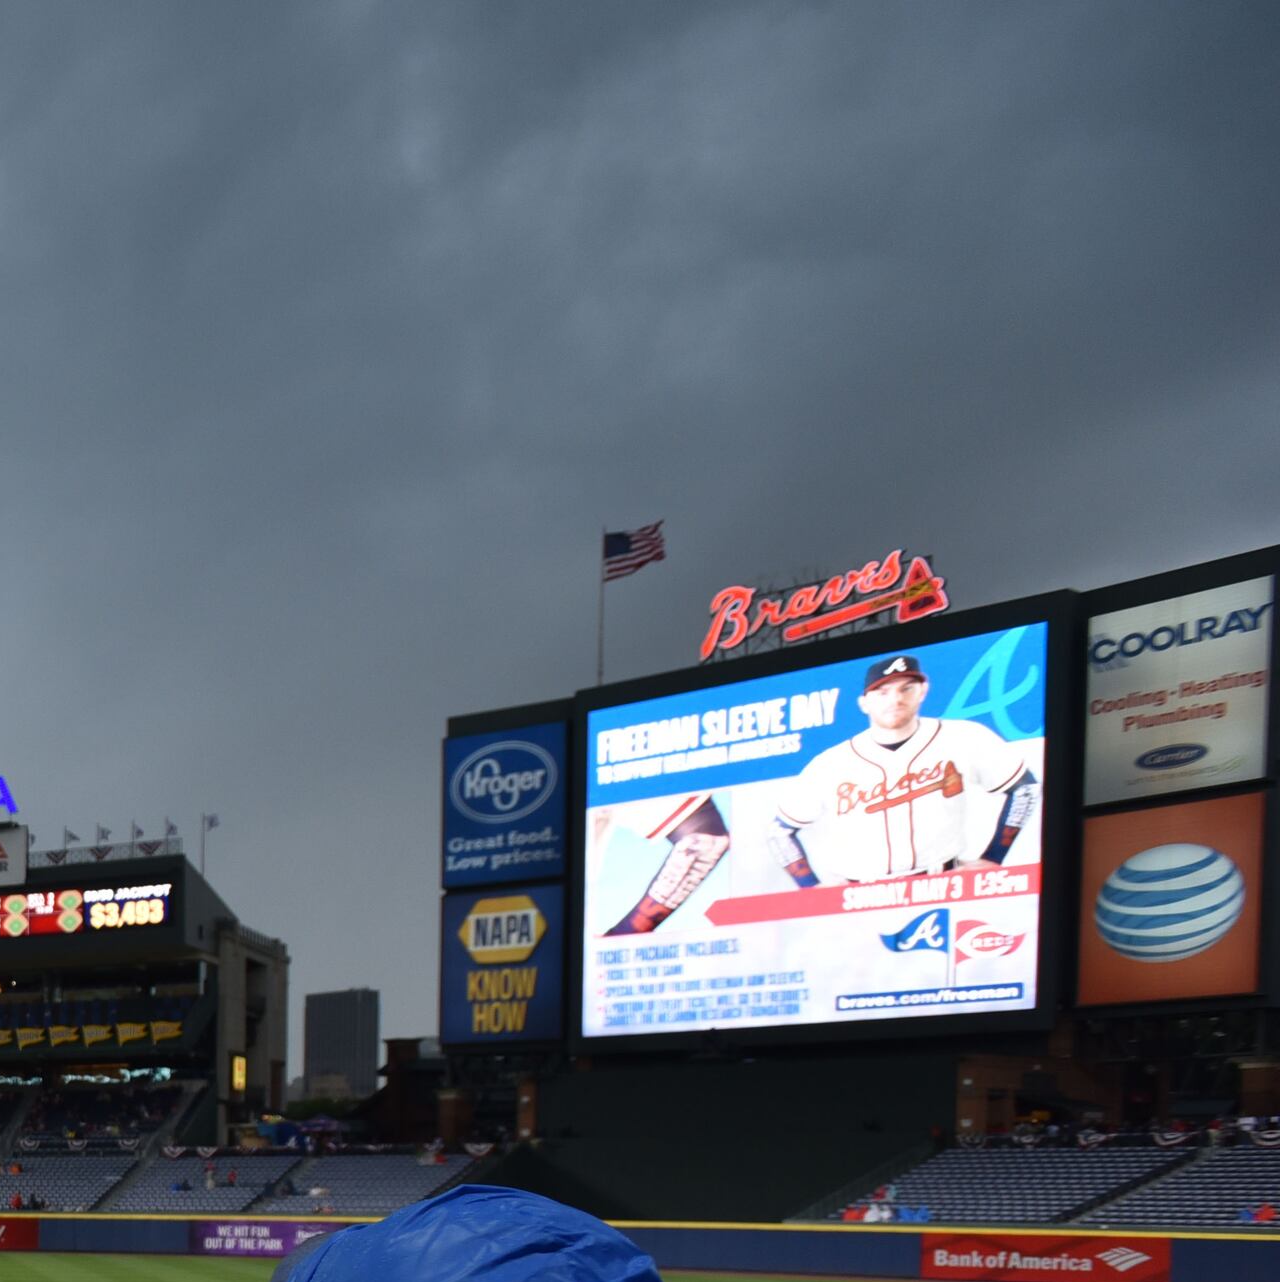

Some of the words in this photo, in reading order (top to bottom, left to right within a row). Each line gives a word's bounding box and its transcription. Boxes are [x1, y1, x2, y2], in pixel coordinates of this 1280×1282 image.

[700, 550, 902, 660] Braves
[1090, 602, 1275, 664] COOLRAY
[1090, 689, 1168, 716] Cooling
[1179, 670, 1268, 699] Heating
[597, 714, 699, 765] FREEMAN
[701, 698, 787, 747] SLEEVE
[789, 688, 839, 731] DAY
[1122, 702, 1228, 733] Plumbing
[464, 758, 546, 811] Kroger
[837, 759, 944, 817] Braves
[448, 834, 503, 853] Great
[507, 826, 560, 848] food.
[446, 854, 487, 872] Low
[491, 848, 561, 872] prices.
[114, 884, 172, 900] JACKPOT
[843, 881, 910, 911] SUNDAY,
[911, 876, 948, 904] MAY
[950, 875, 963, 899] 3
[89, 898, 165, 930] $3,493
[472, 914, 533, 949] NAPA
[971, 935, 1015, 948] REDS
[467, 967, 538, 1002] KNOW
[838, 986, 1019, 1010] braves.com/freeman
[471, 1001, 528, 1034] HOW
[205, 1237, 223, 1250] OUT
[225, 1237, 237, 1250] OF
[239, 1237, 256, 1250] THE
[257, 1237, 283, 1250] PARK
[218, 1225, 233, 1237] WE
[234, 1225, 249, 1237] HIT
[251, 1225, 270, 1237] FUN
[933, 1249, 983, 1267] Bank
[986, 1250, 1006, 1267] of
[1008, 1253, 1093, 1272] America
